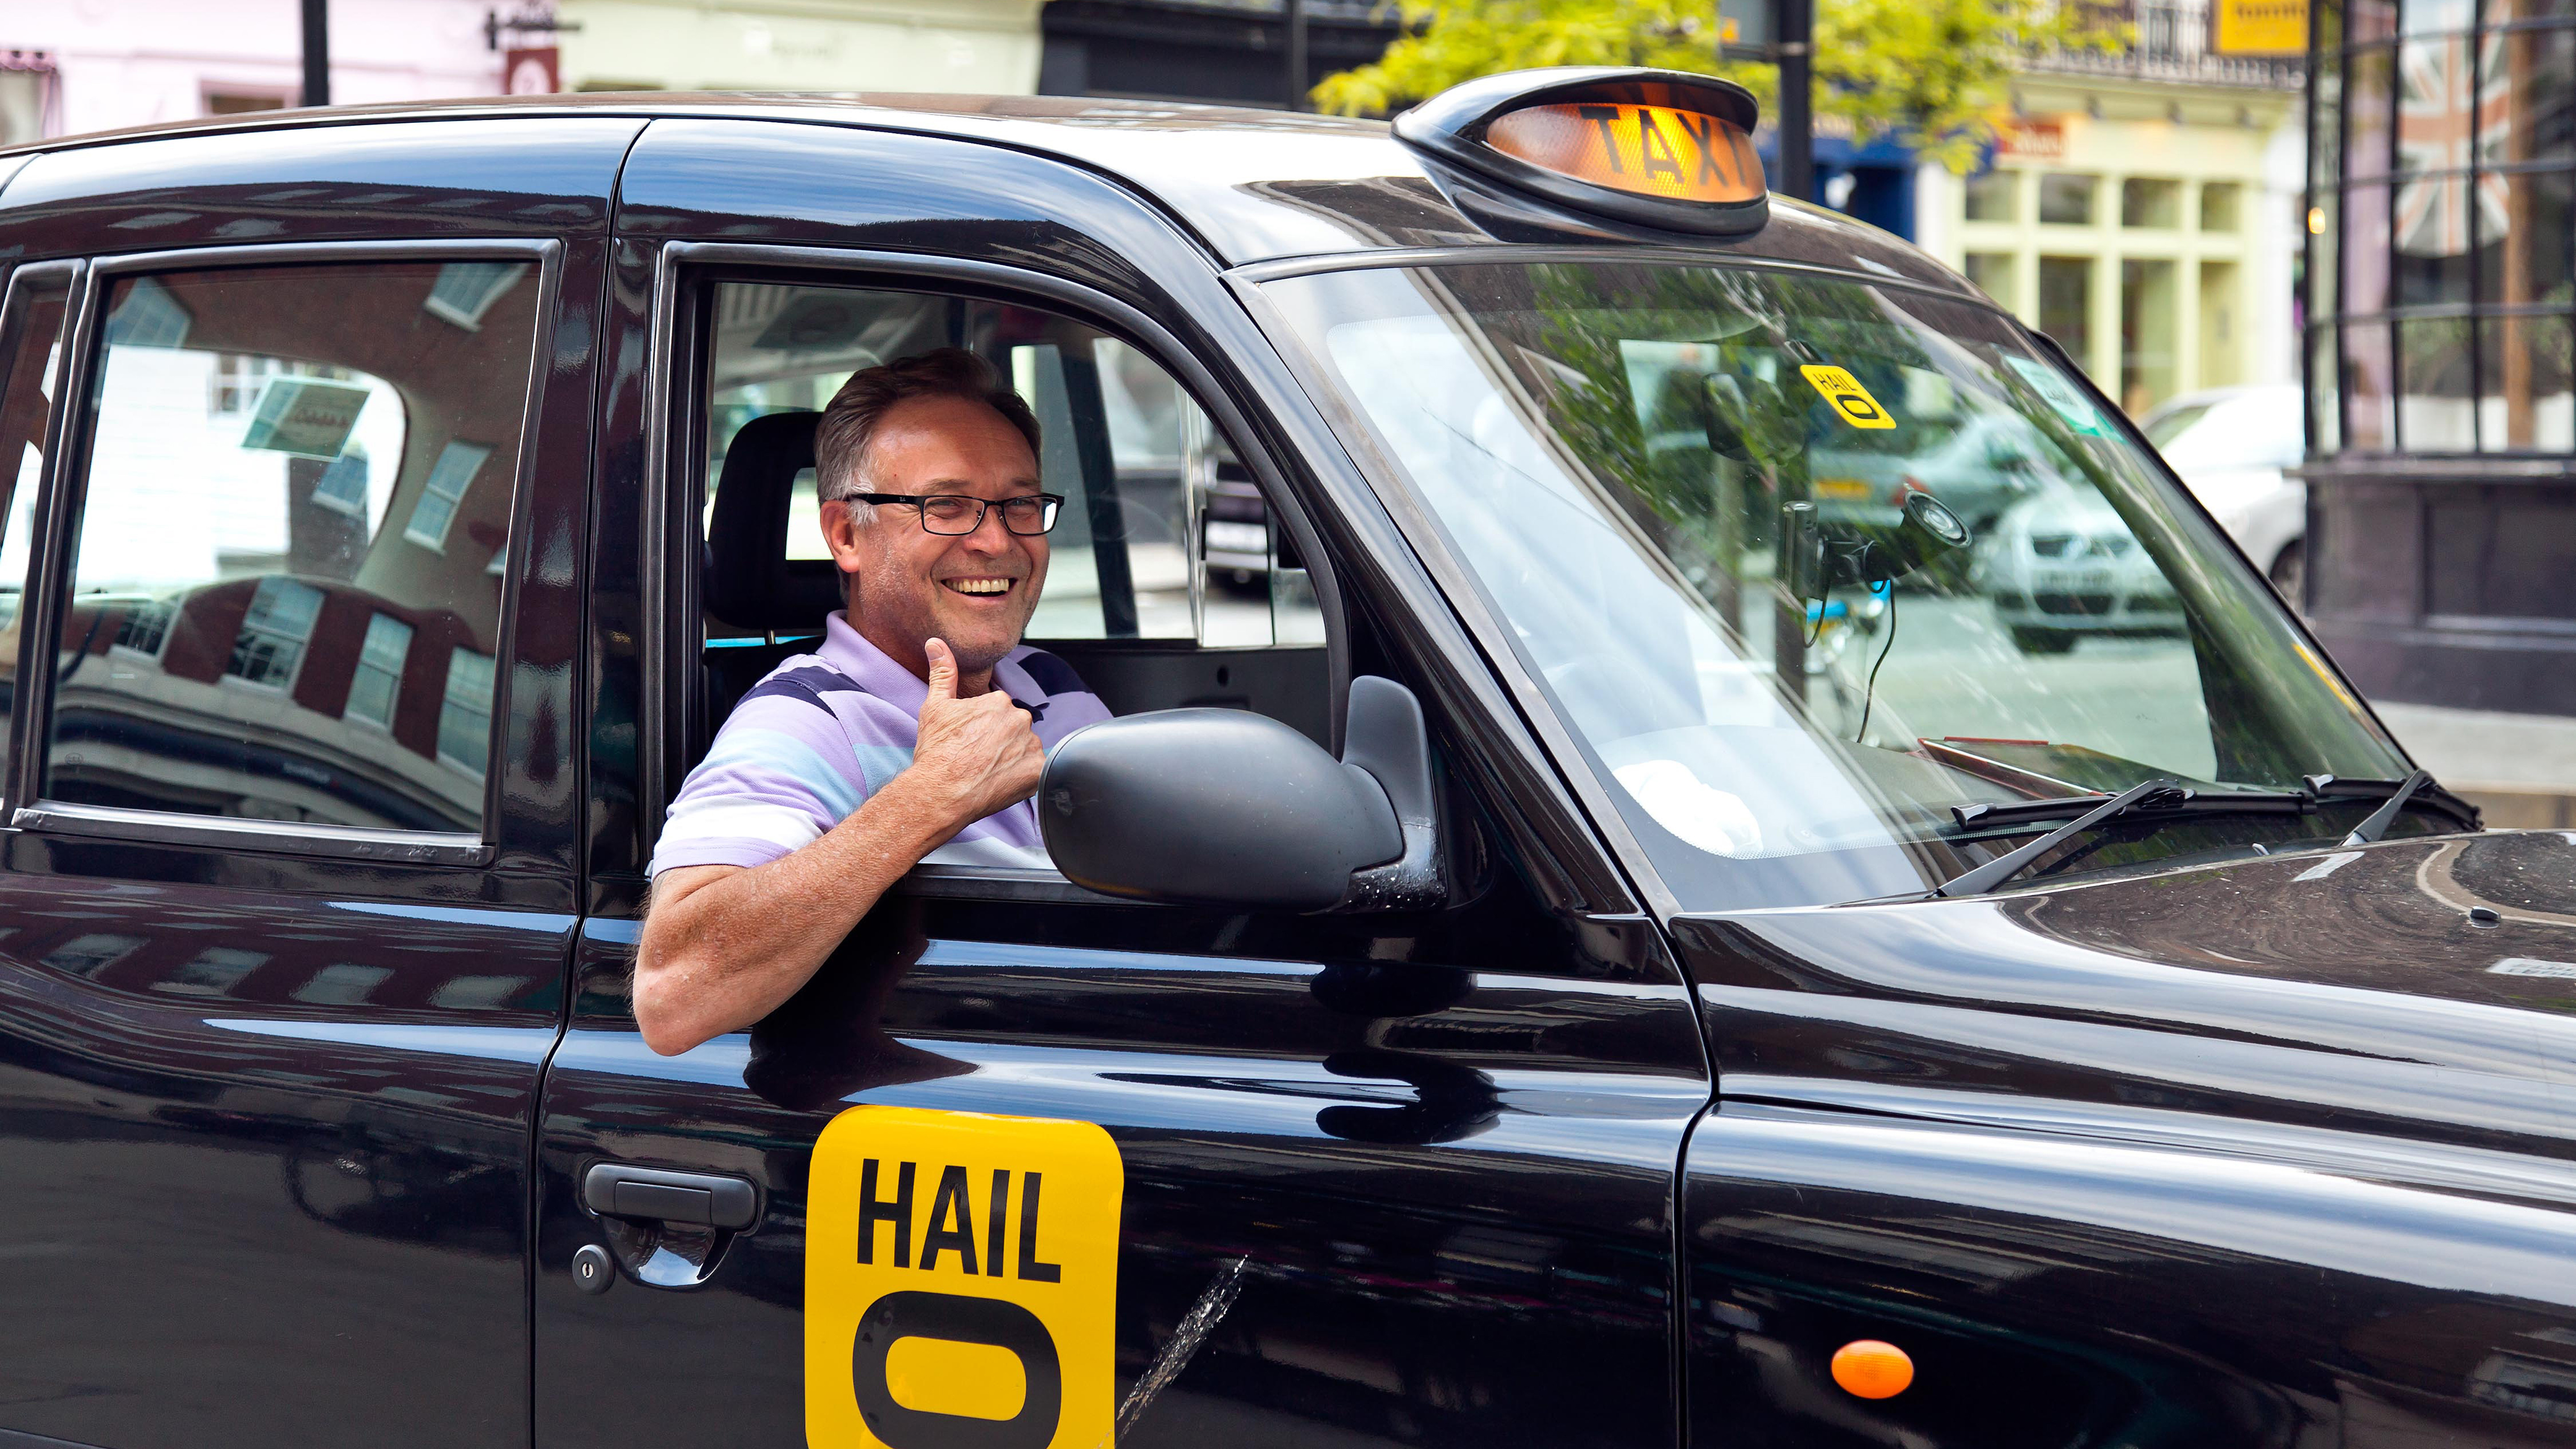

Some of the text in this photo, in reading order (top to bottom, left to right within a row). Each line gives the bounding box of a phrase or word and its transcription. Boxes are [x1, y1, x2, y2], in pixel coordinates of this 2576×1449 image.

[1579, 106, 1745, 186] TAXI
[1813, 373, 1857, 391] HAIL
[857, 1158, 1061, 1284] HAIL
